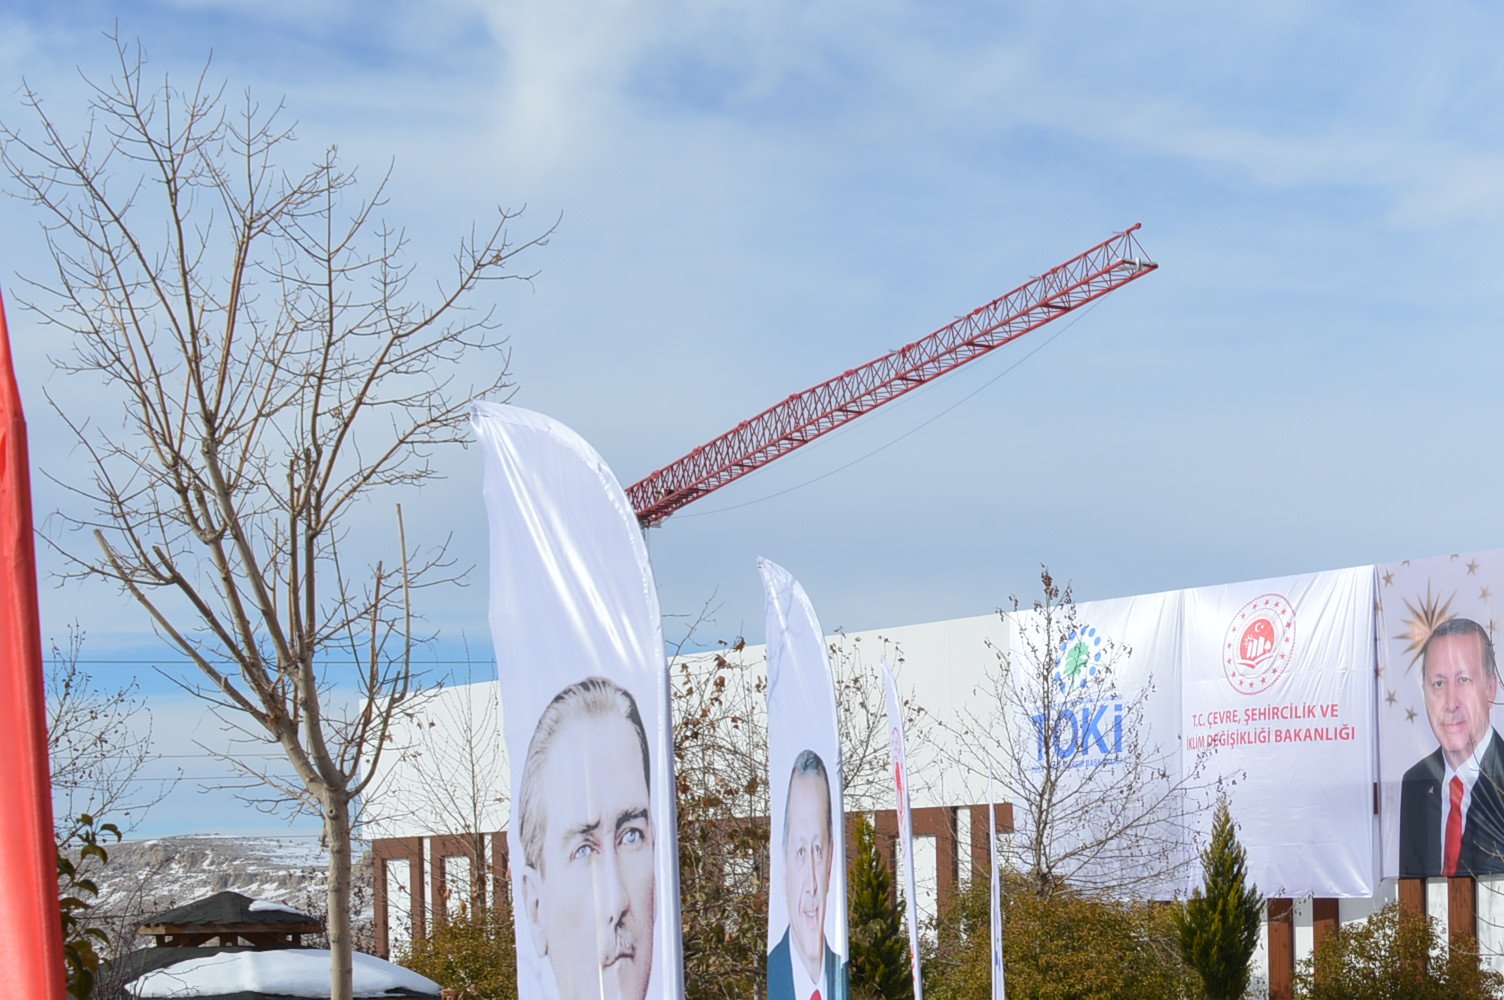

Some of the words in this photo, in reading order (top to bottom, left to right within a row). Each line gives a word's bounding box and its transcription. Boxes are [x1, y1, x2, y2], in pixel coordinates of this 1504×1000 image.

[1192, 713, 1206, 727] T.C.
[1207, 709, 1241, 729] ÇEVRE,
[1244, 702, 1316, 725] ŞEHİRCİLİK
[1320, 703, 1339, 718] VE
[1186, 733, 1205, 750] İKLİM
[1274, 723, 1356, 743] BAKANLIĞI
